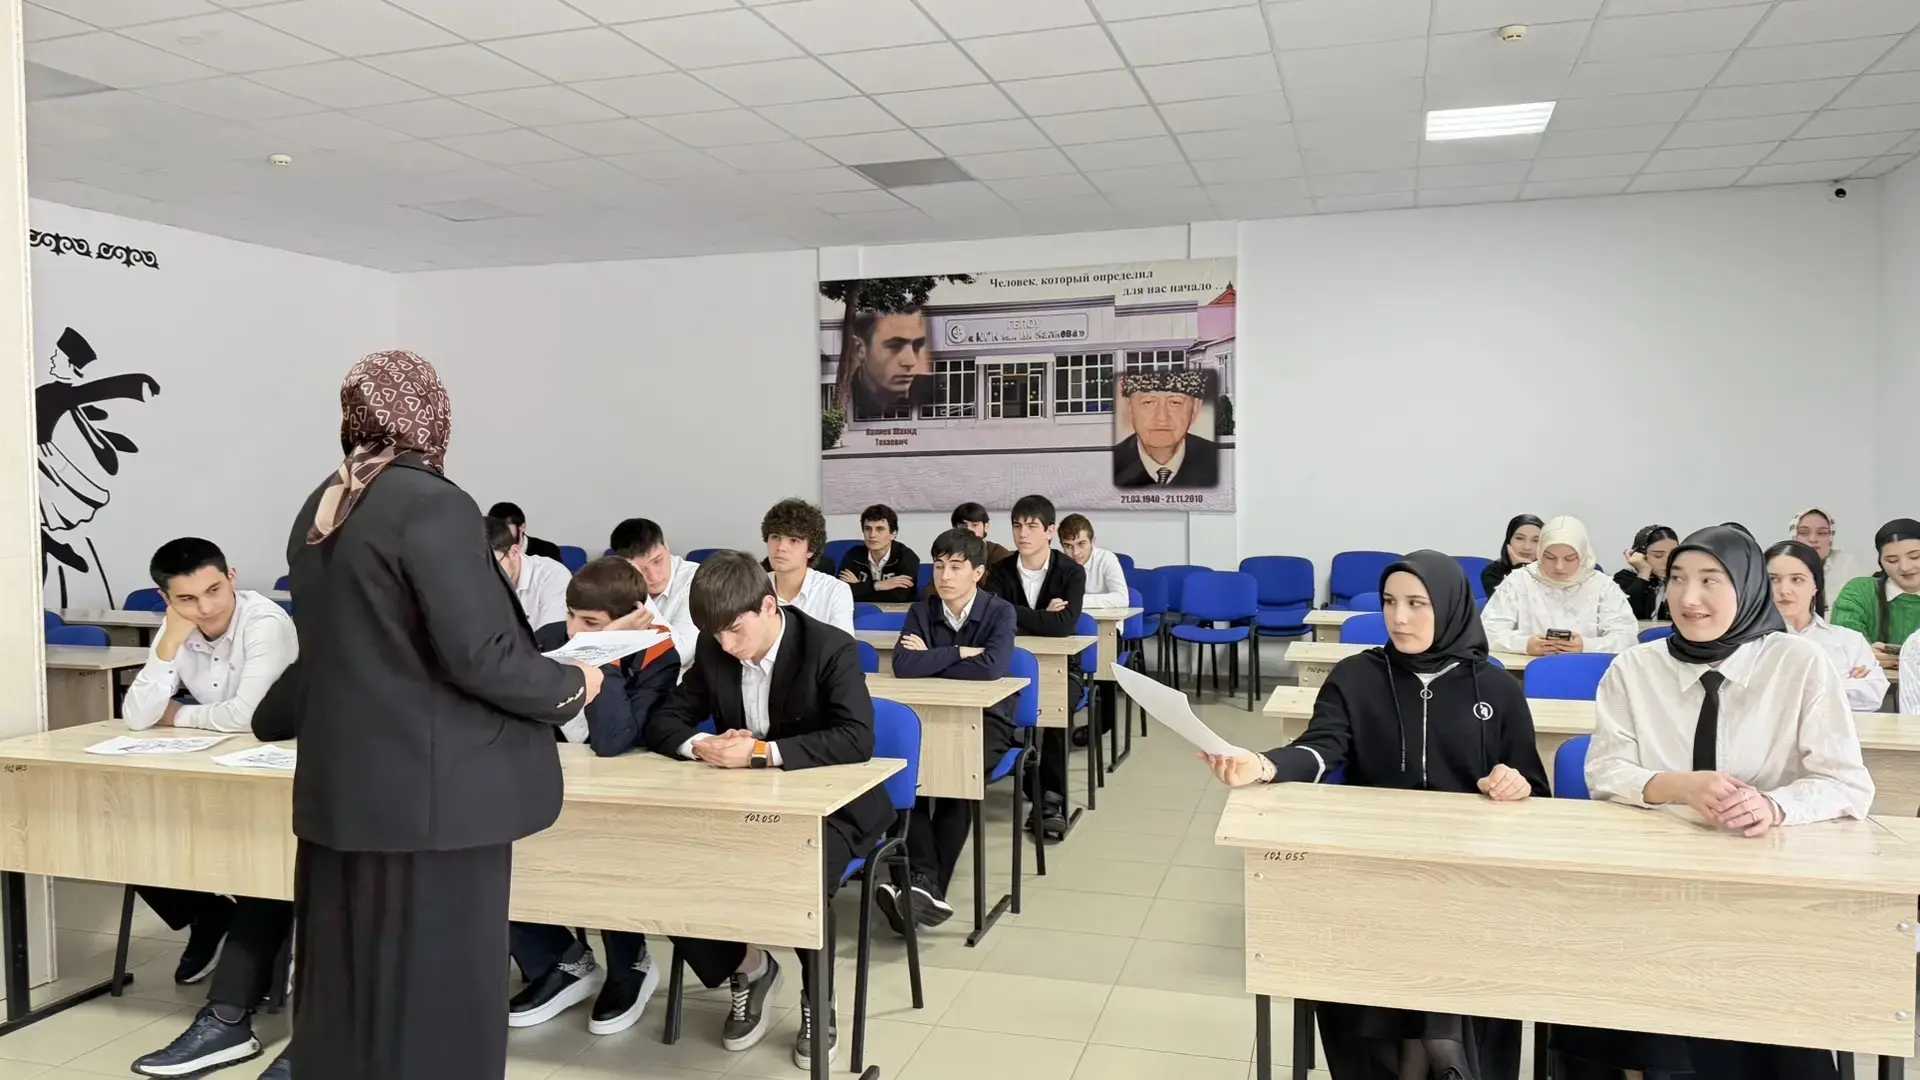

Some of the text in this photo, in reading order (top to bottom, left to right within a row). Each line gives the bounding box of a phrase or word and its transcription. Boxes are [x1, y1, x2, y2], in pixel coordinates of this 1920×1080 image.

[990, 270, 1153, 288] Человек, который определил
[1122, 286, 1144, 296] для
[1147, 285, 1167, 294] нас
[1170, 283, 1212, 293] начало
[1165, 494, 1203, 503] 21.11.2010
